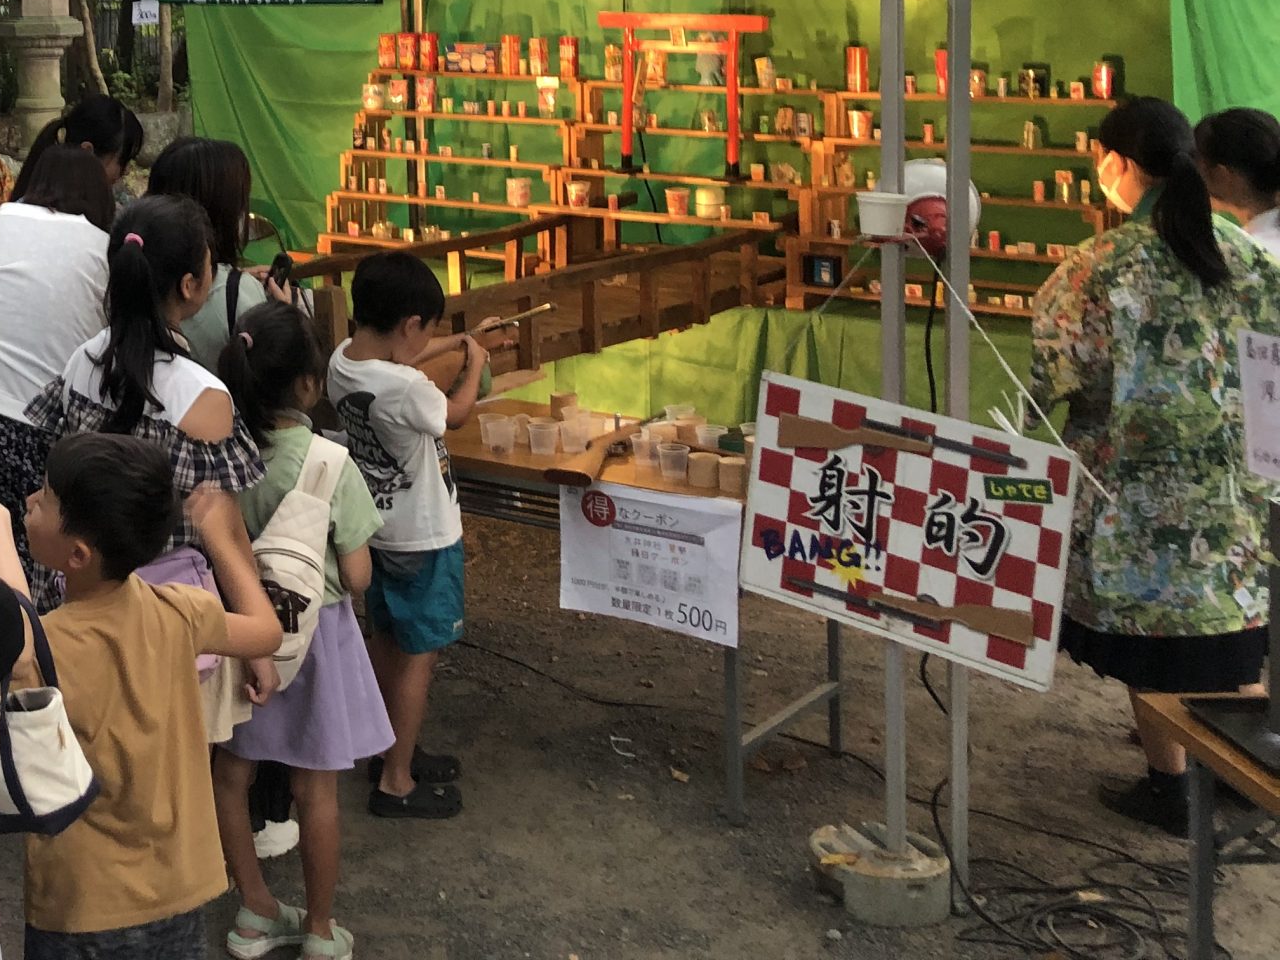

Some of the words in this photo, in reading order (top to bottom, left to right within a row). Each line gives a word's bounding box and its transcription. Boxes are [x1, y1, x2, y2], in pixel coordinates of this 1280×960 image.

[989, 480, 1048, 501] しゃてき
[809, 454, 1007, 577] 射的
[761, 527, 882, 572] BANG!!
[611, 596, 652, 617] 数量限定
[676, 602, 728, 636] 500円
